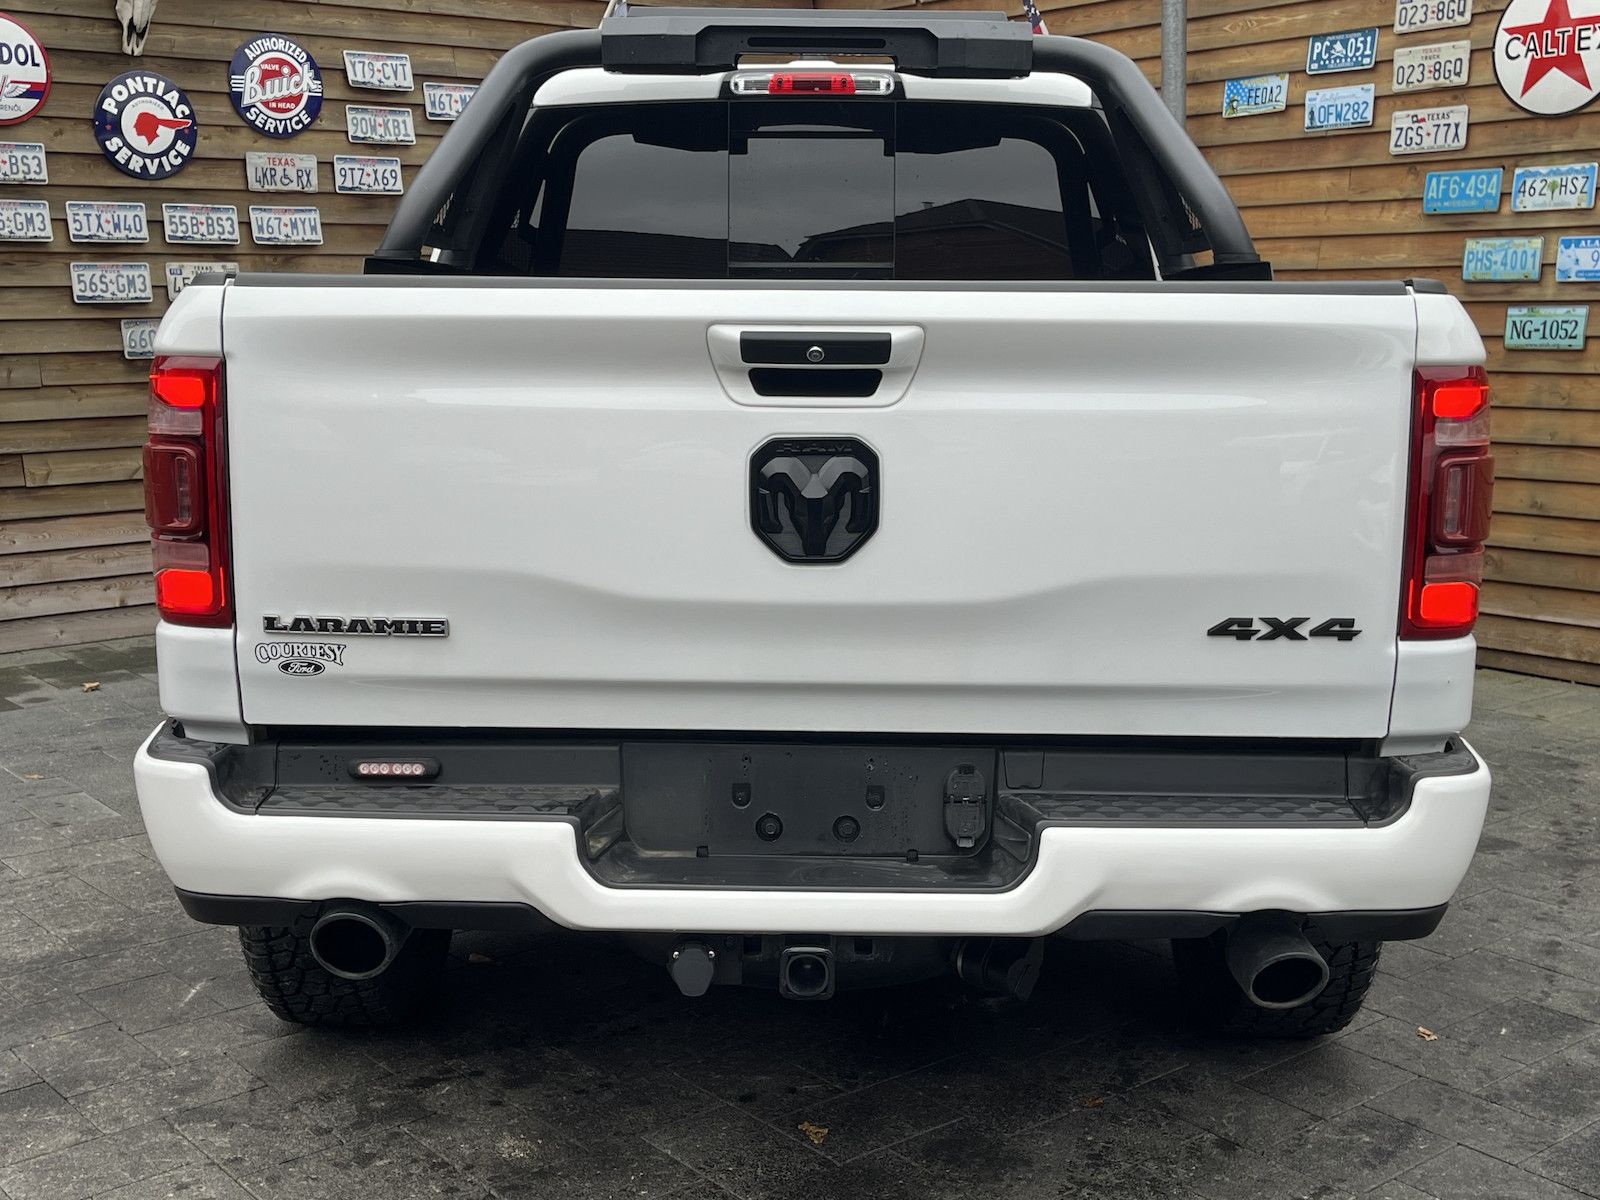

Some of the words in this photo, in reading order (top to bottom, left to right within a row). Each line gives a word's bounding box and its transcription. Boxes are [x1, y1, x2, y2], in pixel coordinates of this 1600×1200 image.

[0, 43, 40, 67] DOL
[244, 37, 307, 63] AUTHORIZED
[1313, 41, 1330, 60] PC
[1347, 36, 1372, 57] 051
[350, 60, 375, 79] Y79
[381, 62, 407, 81] CVT
[242, 63, 317, 106] Buick
[102, 76, 190, 118] PONTIAC
[246, 107, 311, 133] SERVICE
[1427, 111, 1450, 121] TEXAS
[1433, 122, 1460, 144] 77X
[9, 155, 43, 175] BS3
[105, 137, 191, 175] SERVICE
[267, 157, 296, 167] TEXAS
[255, 168, 277, 186] 4KR
[296, 169, 312, 188] RX
[339, 168, 366, 186] 9TZ
[372, 169, 398, 187] X69
[1518, 179, 1547, 197] 462
[1559, 176, 1589, 195] HSZ
[72, 212, 104, 233] 5TX
[206, 216, 235, 236] BS3
[255, 217, 282, 235] W67
[1510, 319, 1579, 340] NG-1052
[263, 615, 449, 637] LARAMIE
[1207, 617, 1362, 641] 4X4
[255, 642, 346, 666] COURTESY
